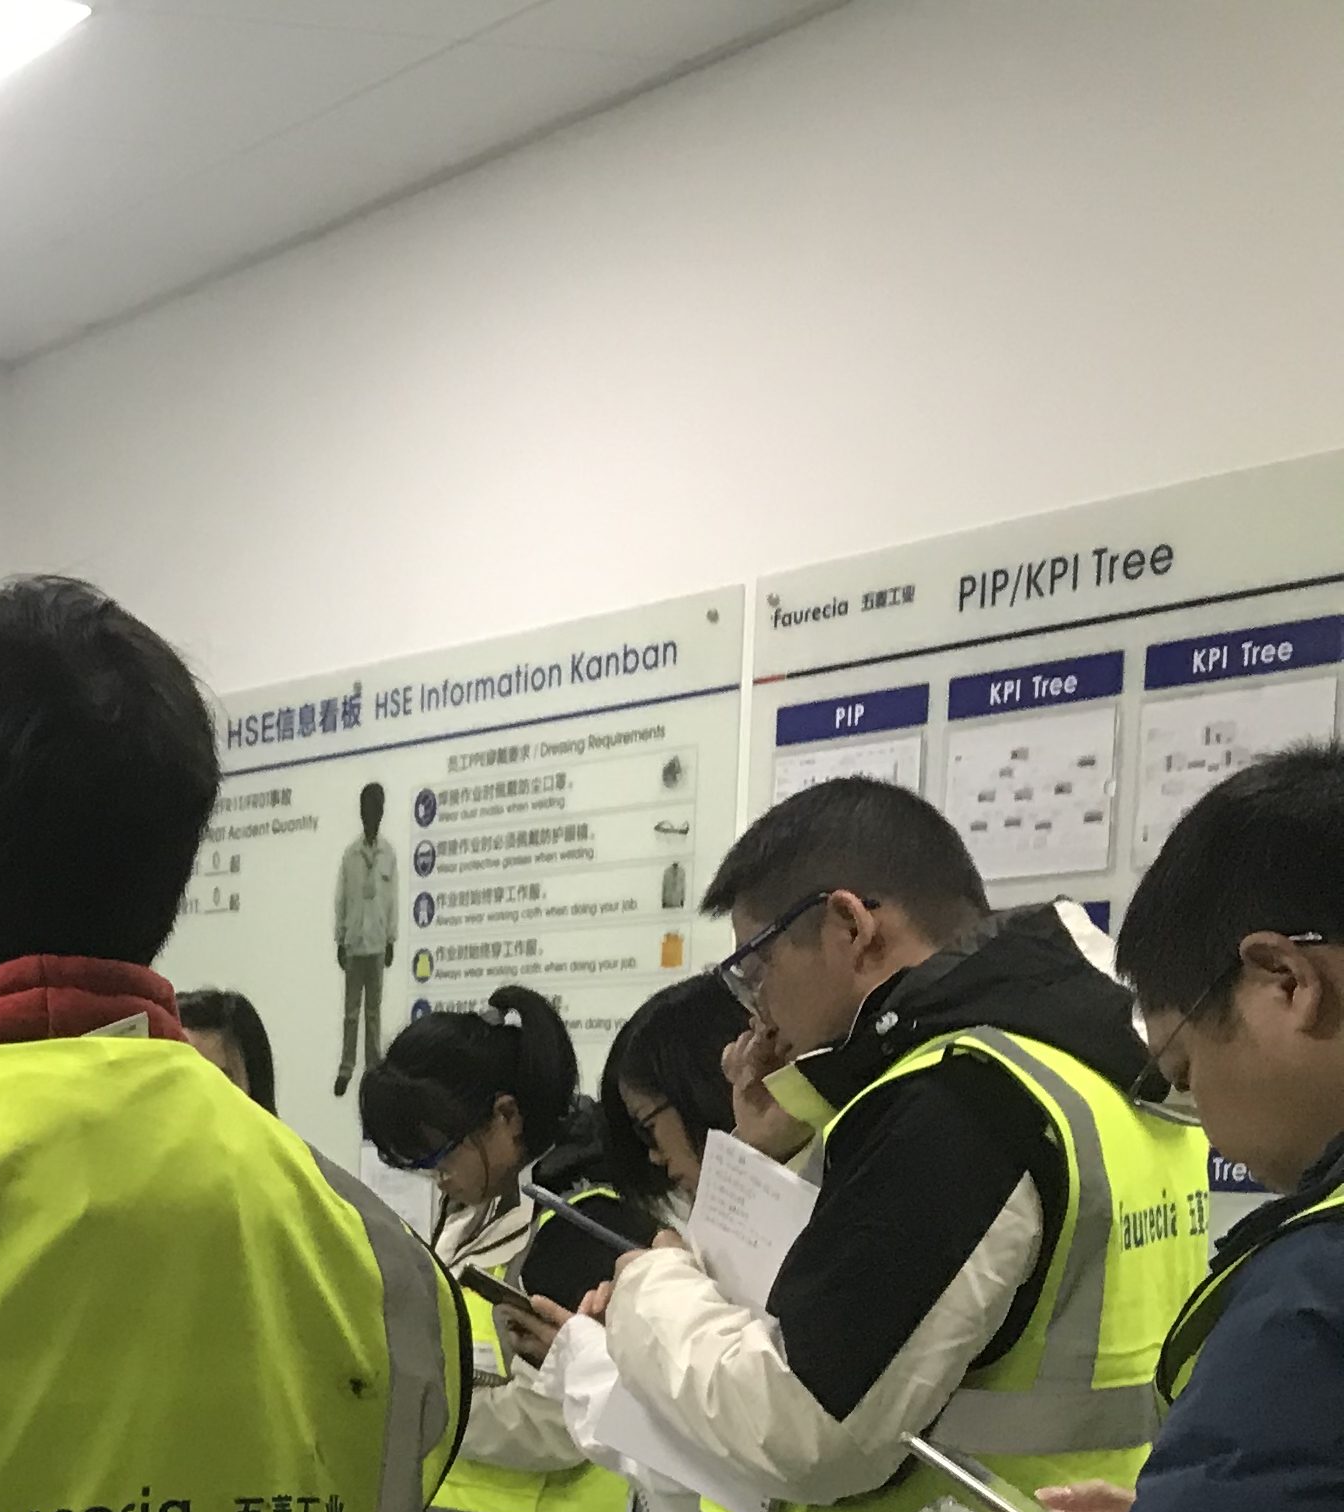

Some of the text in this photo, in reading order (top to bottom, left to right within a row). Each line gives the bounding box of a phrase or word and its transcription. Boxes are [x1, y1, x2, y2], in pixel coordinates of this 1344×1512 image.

[959, 543, 1174, 613] PIP/KPI Tree
[772, 597, 848, 630] faurecia
[1192, 637, 1293, 673] KPI Tree
[227, 639, 678, 749] HSE信息看板 HSE Information Kanban
[989, 671, 1078, 706] KPI Tree
[835, 705, 865, 729] PIP
[1212, 1155, 1256, 1183] Tre
